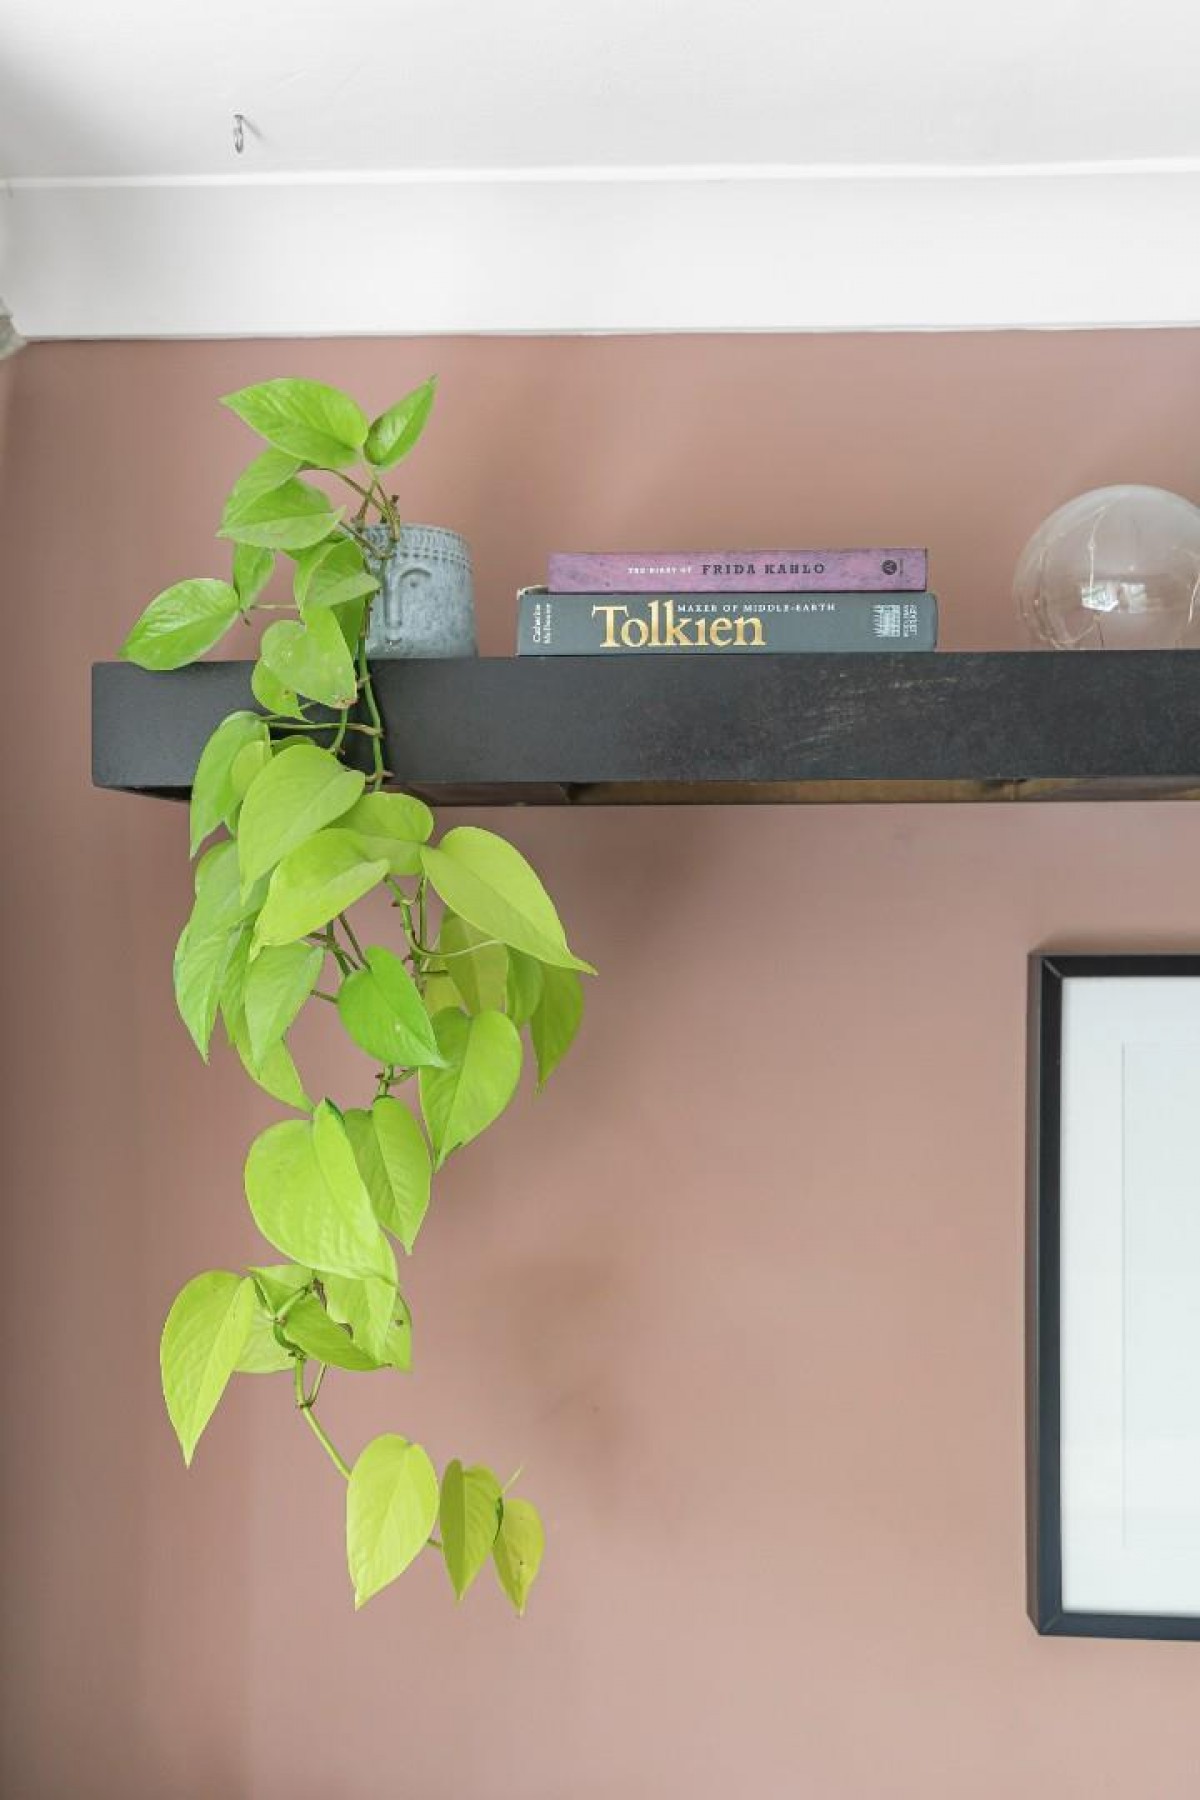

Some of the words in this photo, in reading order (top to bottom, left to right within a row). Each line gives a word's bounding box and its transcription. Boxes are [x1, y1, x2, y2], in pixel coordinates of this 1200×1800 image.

[702, 564, 756, 576] FRIDA
[764, 563, 825, 574] KAHLO
[677, 604, 718, 613] MAKER
[722, 604, 738, 613] OF
[742, 602, 836, 613] MIDDLE-EARTH
[591, 600, 767, 647] Tolkien
